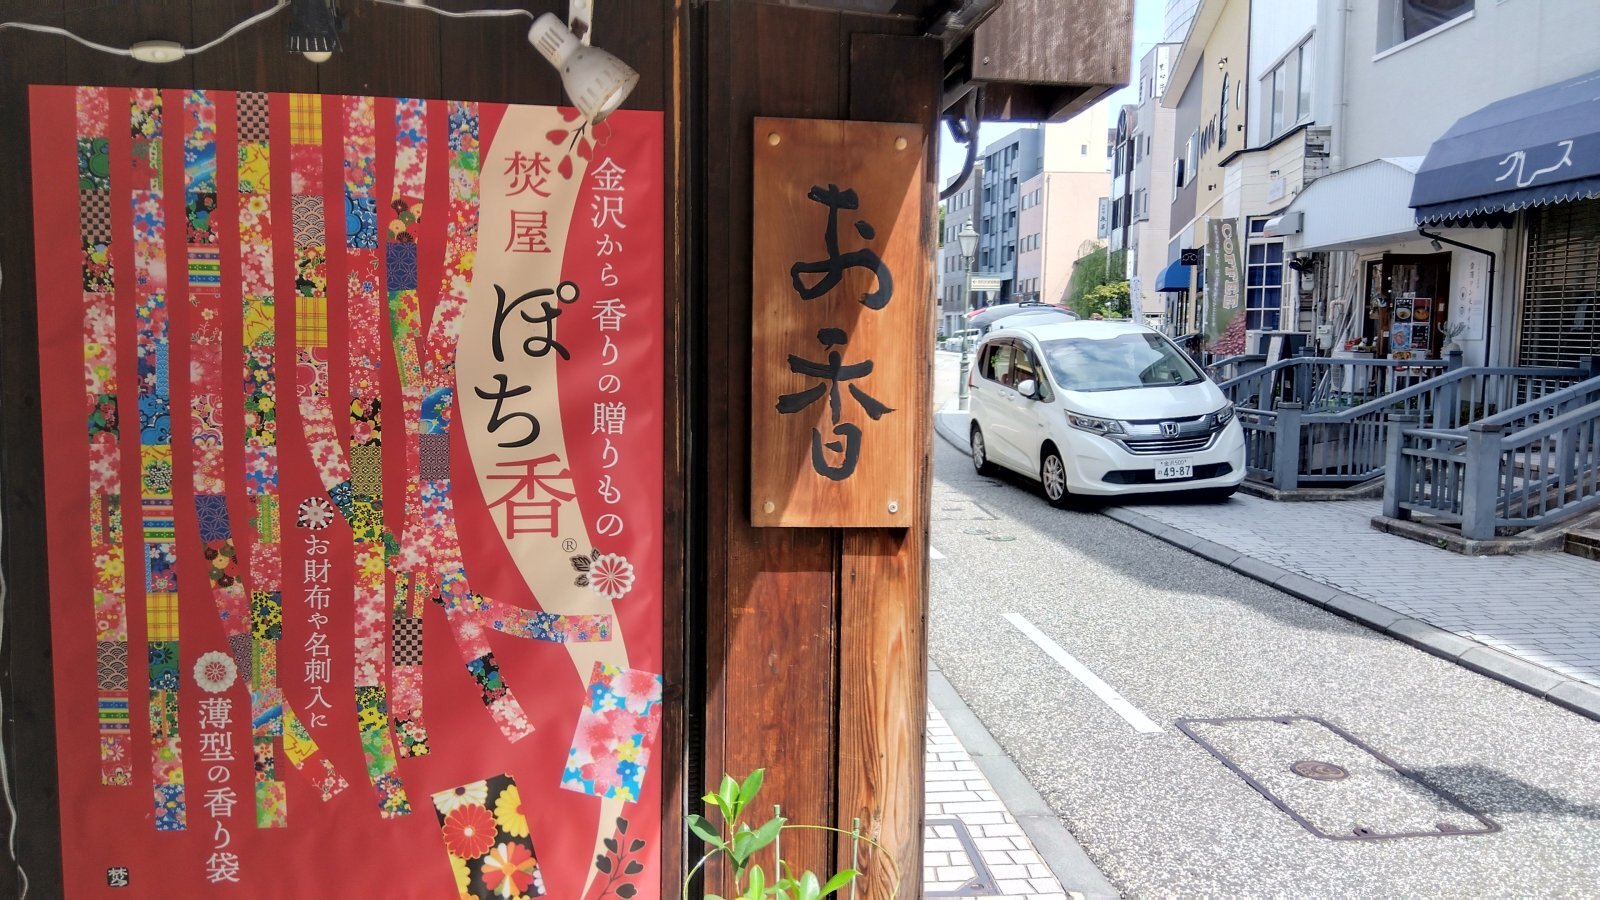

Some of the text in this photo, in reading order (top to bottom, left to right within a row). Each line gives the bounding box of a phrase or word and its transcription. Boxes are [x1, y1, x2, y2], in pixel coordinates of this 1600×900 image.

[474, 151, 580, 539] 焚屋 ぽち香
[591, 156, 627, 537] 金沢から香りの贈りもの
[775, 183, 898, 481] お香
[1222, 223, 1239, 309] COFFEE
[1163, 465, 1190, 477] 49-87
[303, 535, 332, 728] お財布や名刺入に
[197, 697, 240, 883] 薄型の香り袋
